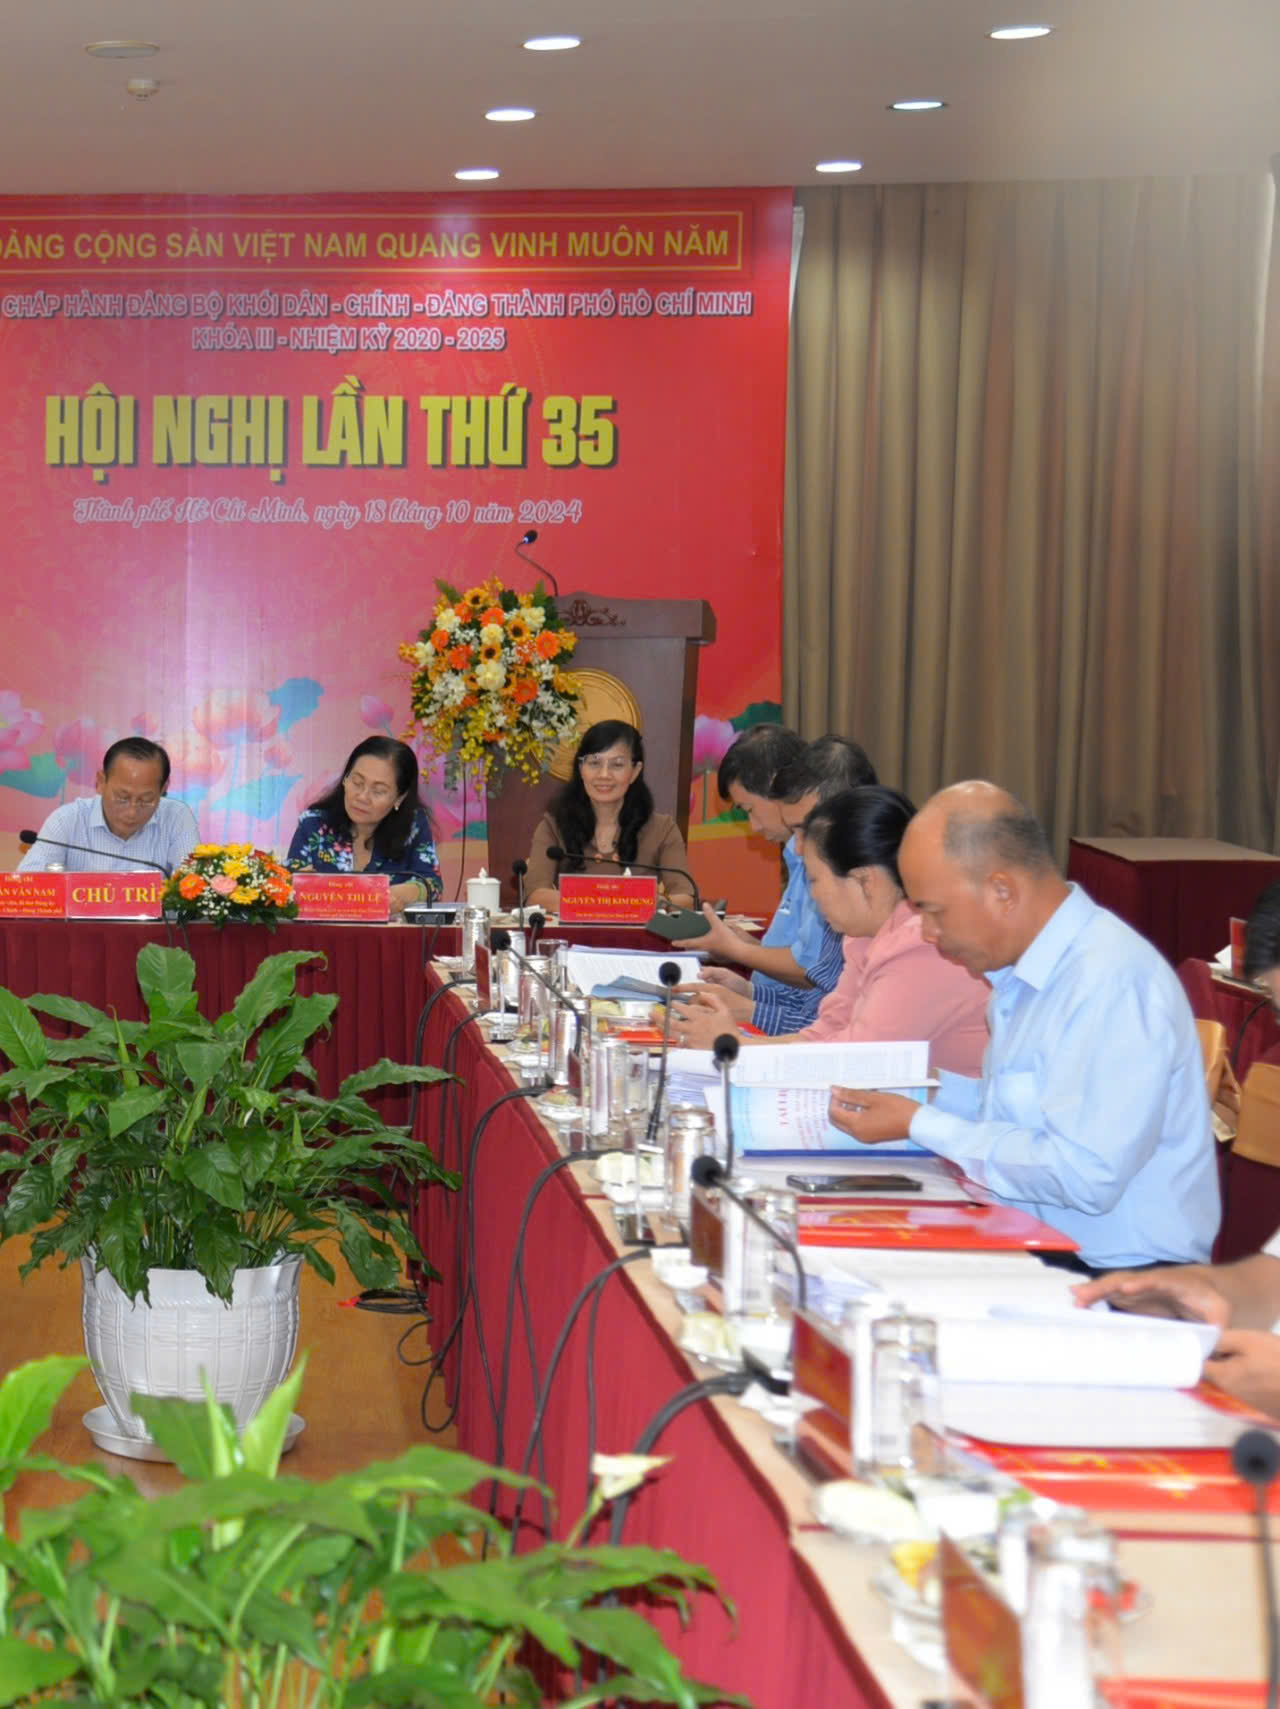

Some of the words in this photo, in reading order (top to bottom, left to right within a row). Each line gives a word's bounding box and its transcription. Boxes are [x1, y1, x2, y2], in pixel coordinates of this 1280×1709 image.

[74, 229, 157, 264] CỘNG
[166, 227, 224, 258] SẢN
[232, 228, 295, 264] VIỆT
[304, 232, 367, 257] NAM
[376, 232, 481, 258] QUANG
[490, 231, 557, 257] VINH
[568, 224, 654, 257] MUÔN
[664, 224, 729, 256] NĂM
[2, 290, 61, 318] CHẤP
[64, 289, 122, 317] HÀNH
[126, 289, 188, 317] ĐẢNG
[191, 290, 225, 320] BỘ
[227, 289, 280, 317] KHỐI
[282, 289, 328, 317] DÂN
[344, 289, 411, 317] CHÍNH
[425, 288, 489, 316] ĐẢNG
[492, 288, 565, 317] THÀNH
[570, 288, 616, 316] PHỐ
[619, 288, 653, 315] HỒ
[655, 287, 694, 315] CHÍ
[696, 291, 752, 315] MINH
[192, 322, 253, 350] KHÓA
[255, 327, 275, 350] III
[289, 324, 358, 354] NHIỆM
[360, 322, 393, 350] KỲ
[394, 327, 442, 350] 2020
[456, 327, 506, 350] 2025
[44, 381, 136, 482] HỘI
[152, 394, 287, 482] NGHỊ
[302, 375, 405, 466] LẦN
[420, 382, 529, 466] THỨ
[542, 394, 615, 466] 35
[73, 497, 134, 524] Thành
[133, 497, 172, 528] phố
[175, 497, 210, 523] Hồ
[211, 497, 247, 523] Chí
[314, 500, 362, 529] ngày
[364, 499, 385, 523] 18
[388, 498, 443, 530] tháng
[446, 499, 469, 523] 10
[473, 503, 514, 523] năm
[518, 499, 582, 524] 2024
[72, 882, 116, 904] CHỦ
[121, 882, 157, 904] TRÌ
